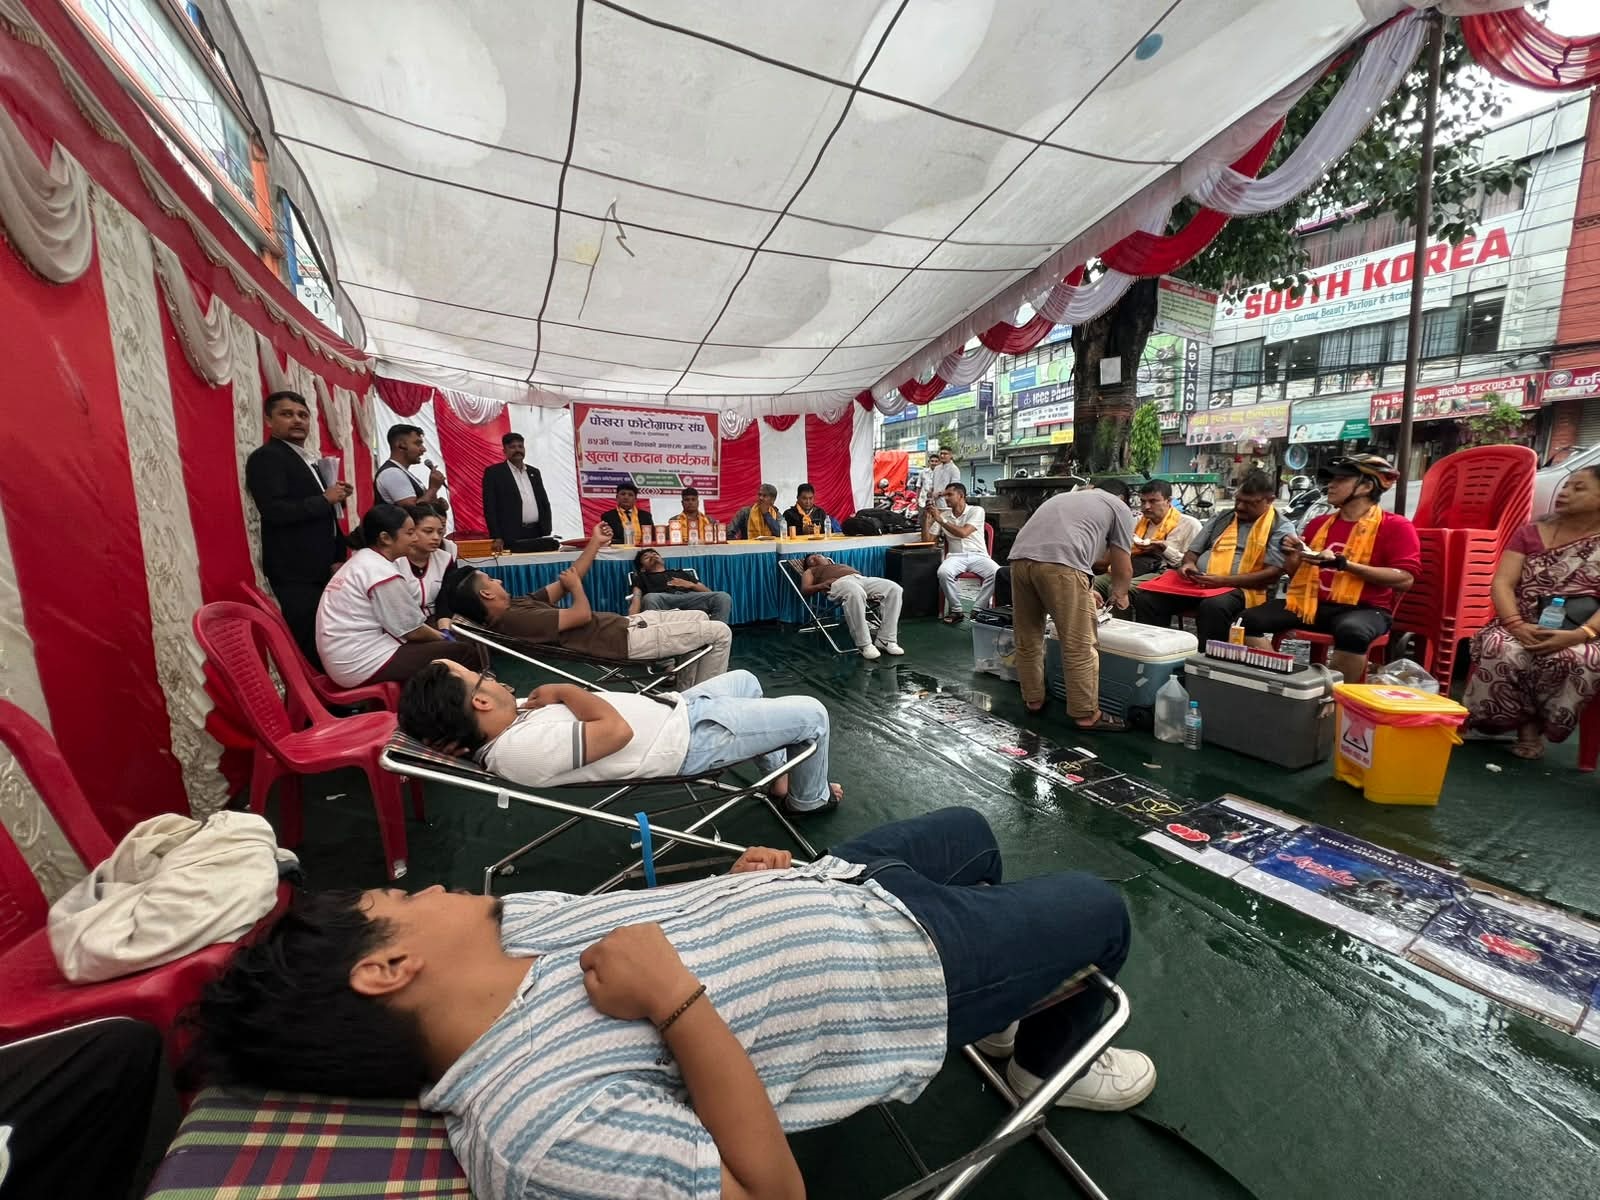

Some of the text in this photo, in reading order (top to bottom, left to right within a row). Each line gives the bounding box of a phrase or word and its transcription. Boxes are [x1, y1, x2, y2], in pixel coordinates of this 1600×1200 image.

[1244, 268, 1350, 320] SOUTH
[1362, 227, 1511, 292] KOREA
[1333, 260, 1359, 271] STUDY
[1320, 304, 1346, 319] Beauty
[1346, 297, 1378, 314] Parlour
[1379, 294, 1386, 304] &
[1374, 391, 1435, 407] The Boique
[590, 415, 704, 433] पोखरा फोटोग्राफर संघ
[585, 451, 710, 466] खुल्ला रक्तदान कार्यक्रम
